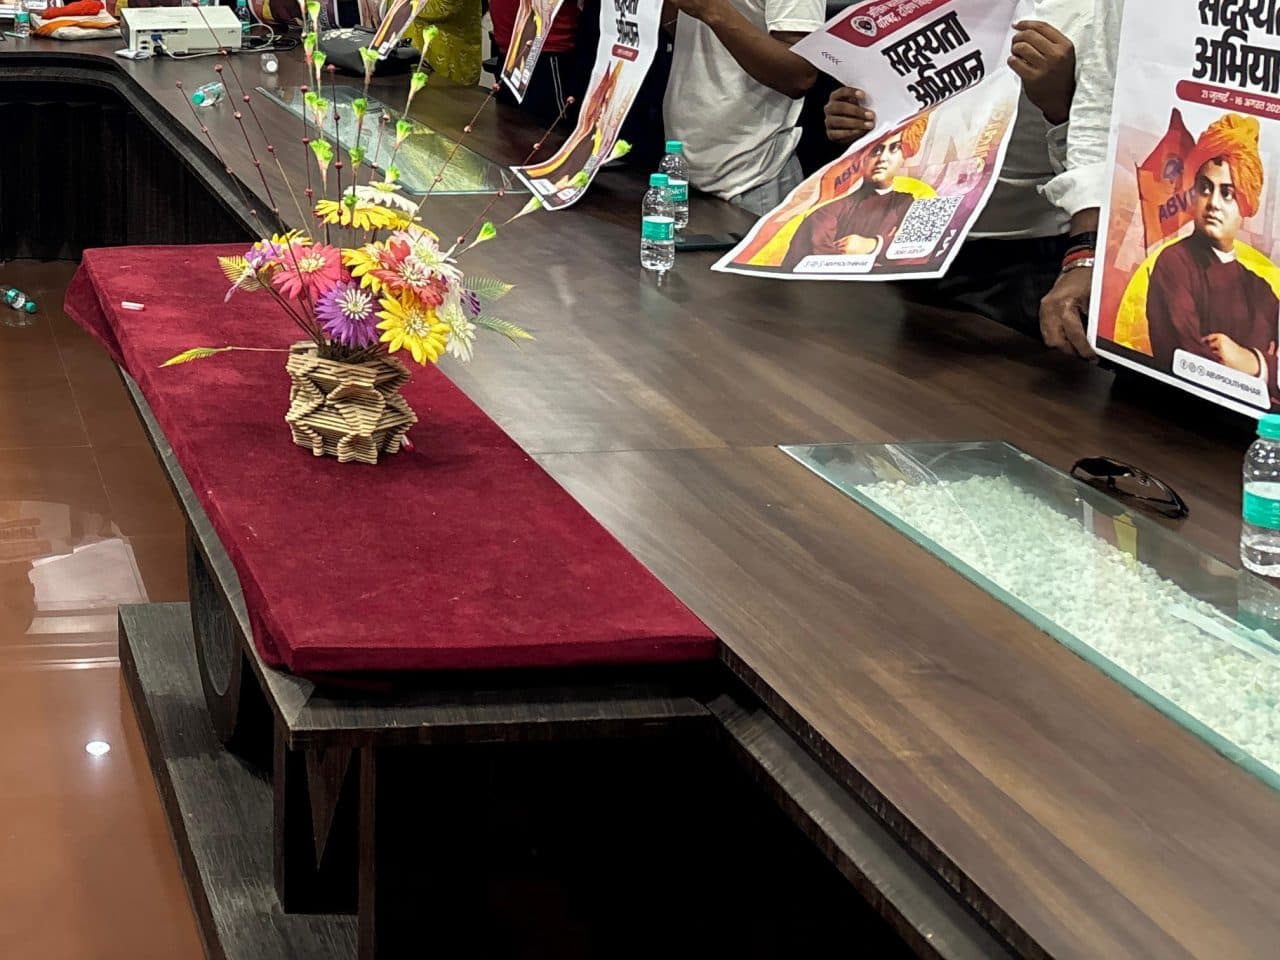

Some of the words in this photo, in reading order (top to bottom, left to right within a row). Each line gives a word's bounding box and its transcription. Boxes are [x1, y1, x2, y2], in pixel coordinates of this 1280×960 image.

[880, 10, 971, 77] सदस्यता
[1192, 27, 1280, 94] अभिया
[906, 49, 985, 111] अभियान
